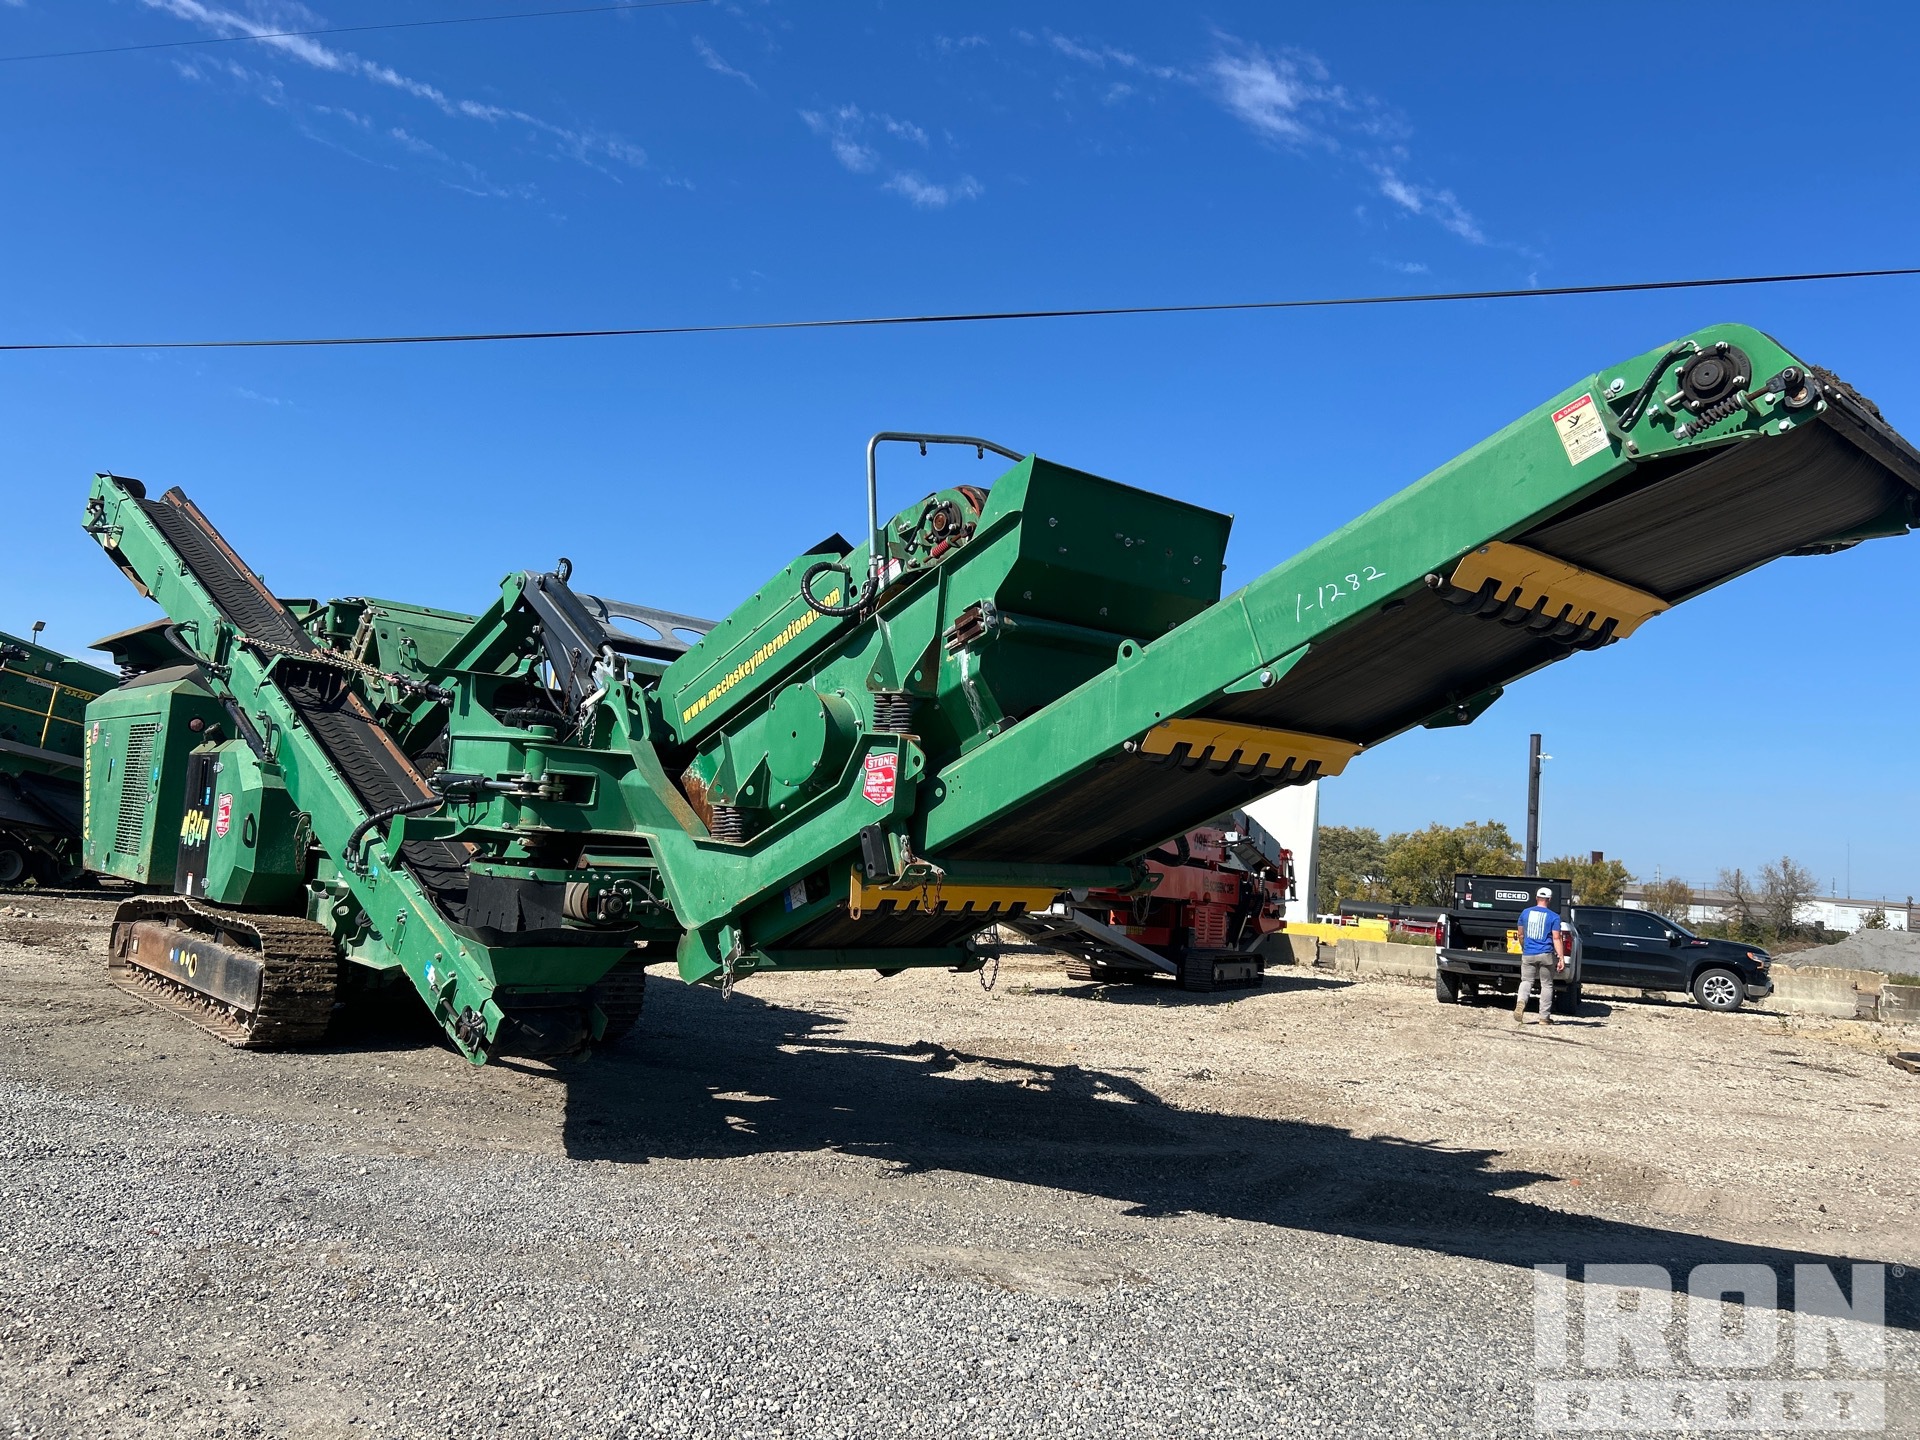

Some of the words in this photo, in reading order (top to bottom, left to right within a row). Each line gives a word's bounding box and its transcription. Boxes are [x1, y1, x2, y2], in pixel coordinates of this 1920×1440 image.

[1563, 399, 1587, 416] DANGER
[1296, 566, 1387, 623] 1-1282
[867, 756, 895, 769] STONE
[1497, 892, 1527, 900] DECKED
